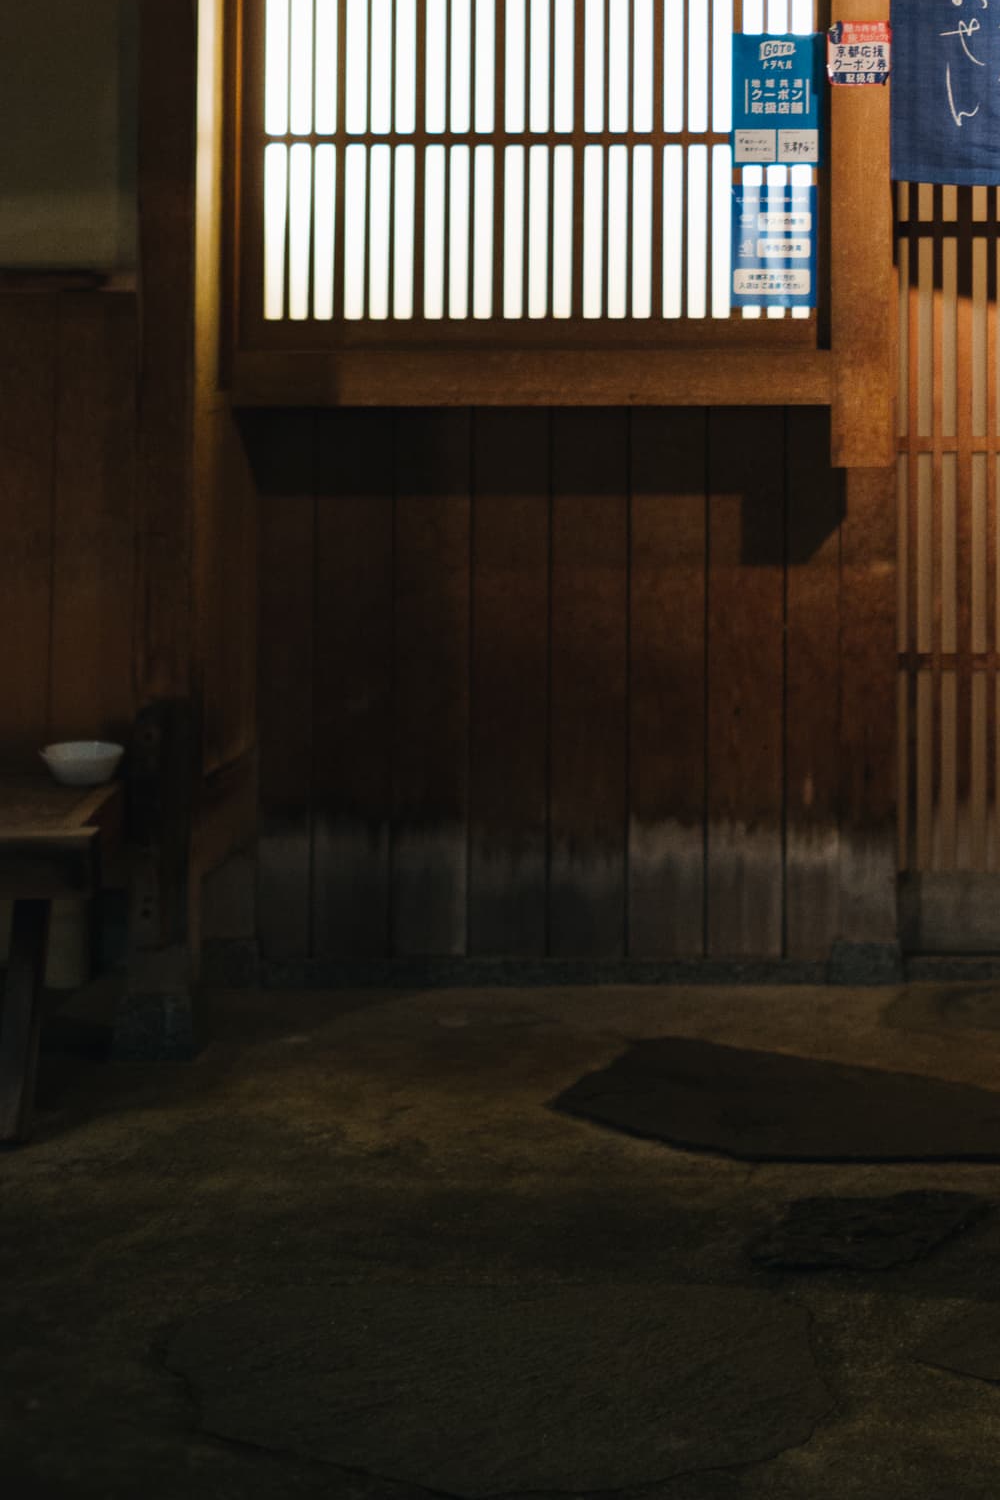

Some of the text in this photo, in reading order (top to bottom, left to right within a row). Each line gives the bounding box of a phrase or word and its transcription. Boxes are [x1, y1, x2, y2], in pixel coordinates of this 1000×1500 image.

[835, 45, 884, 58] 京都応援
[762, 60, 793, 70] トラベル
[834, 59, 886, 71] クーポン券
[751, 89, 803, 101] クーポン
[751, 102, 803, 114] 取扱店舗
